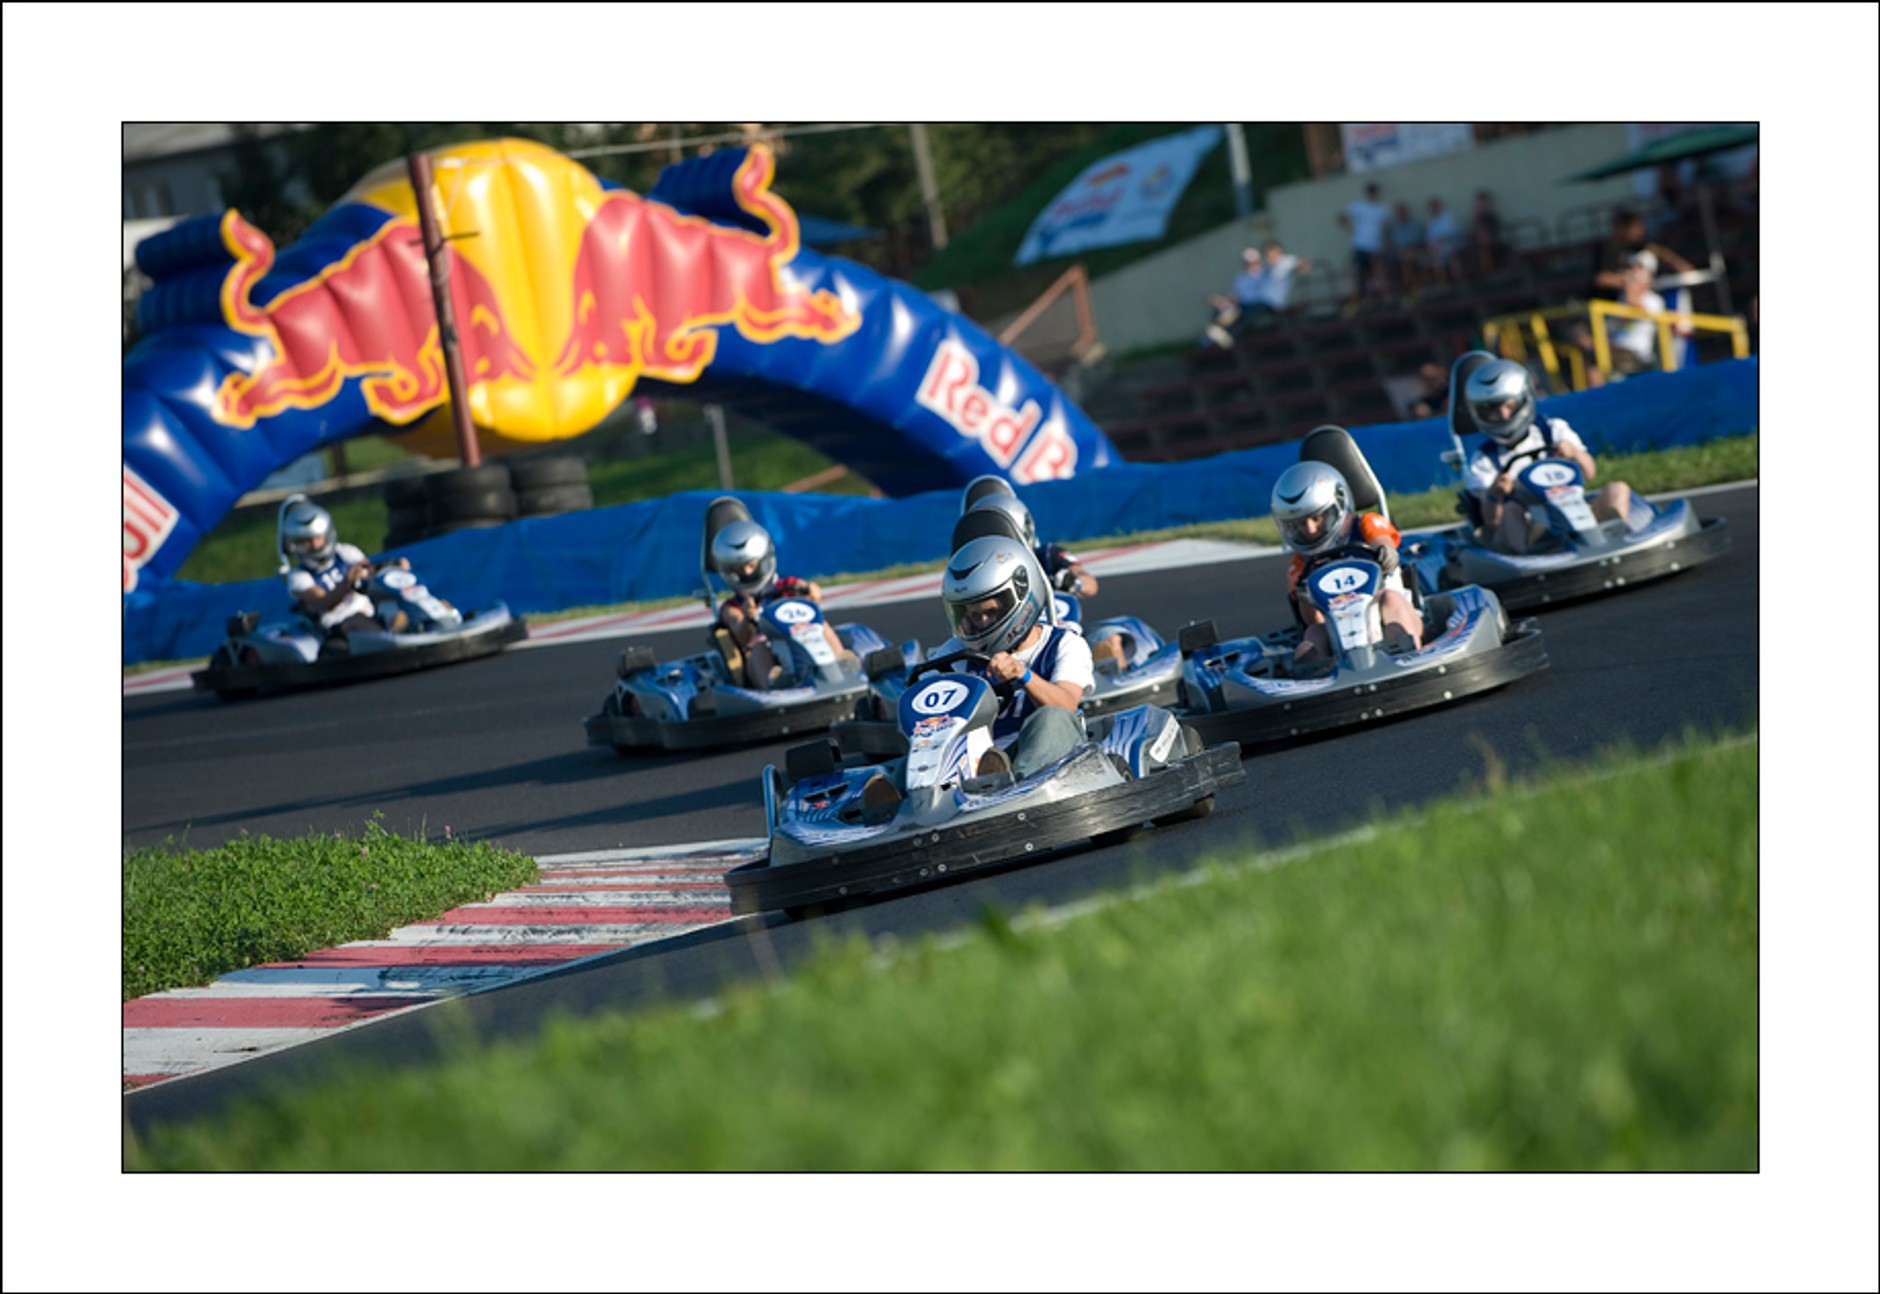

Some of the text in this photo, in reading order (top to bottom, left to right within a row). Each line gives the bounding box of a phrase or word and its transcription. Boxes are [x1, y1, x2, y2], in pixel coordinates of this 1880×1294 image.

[922, 344, 1038, 459] Red
[1333, 574, 1355, 590] 14
[924, 687, 957, 708] 07
